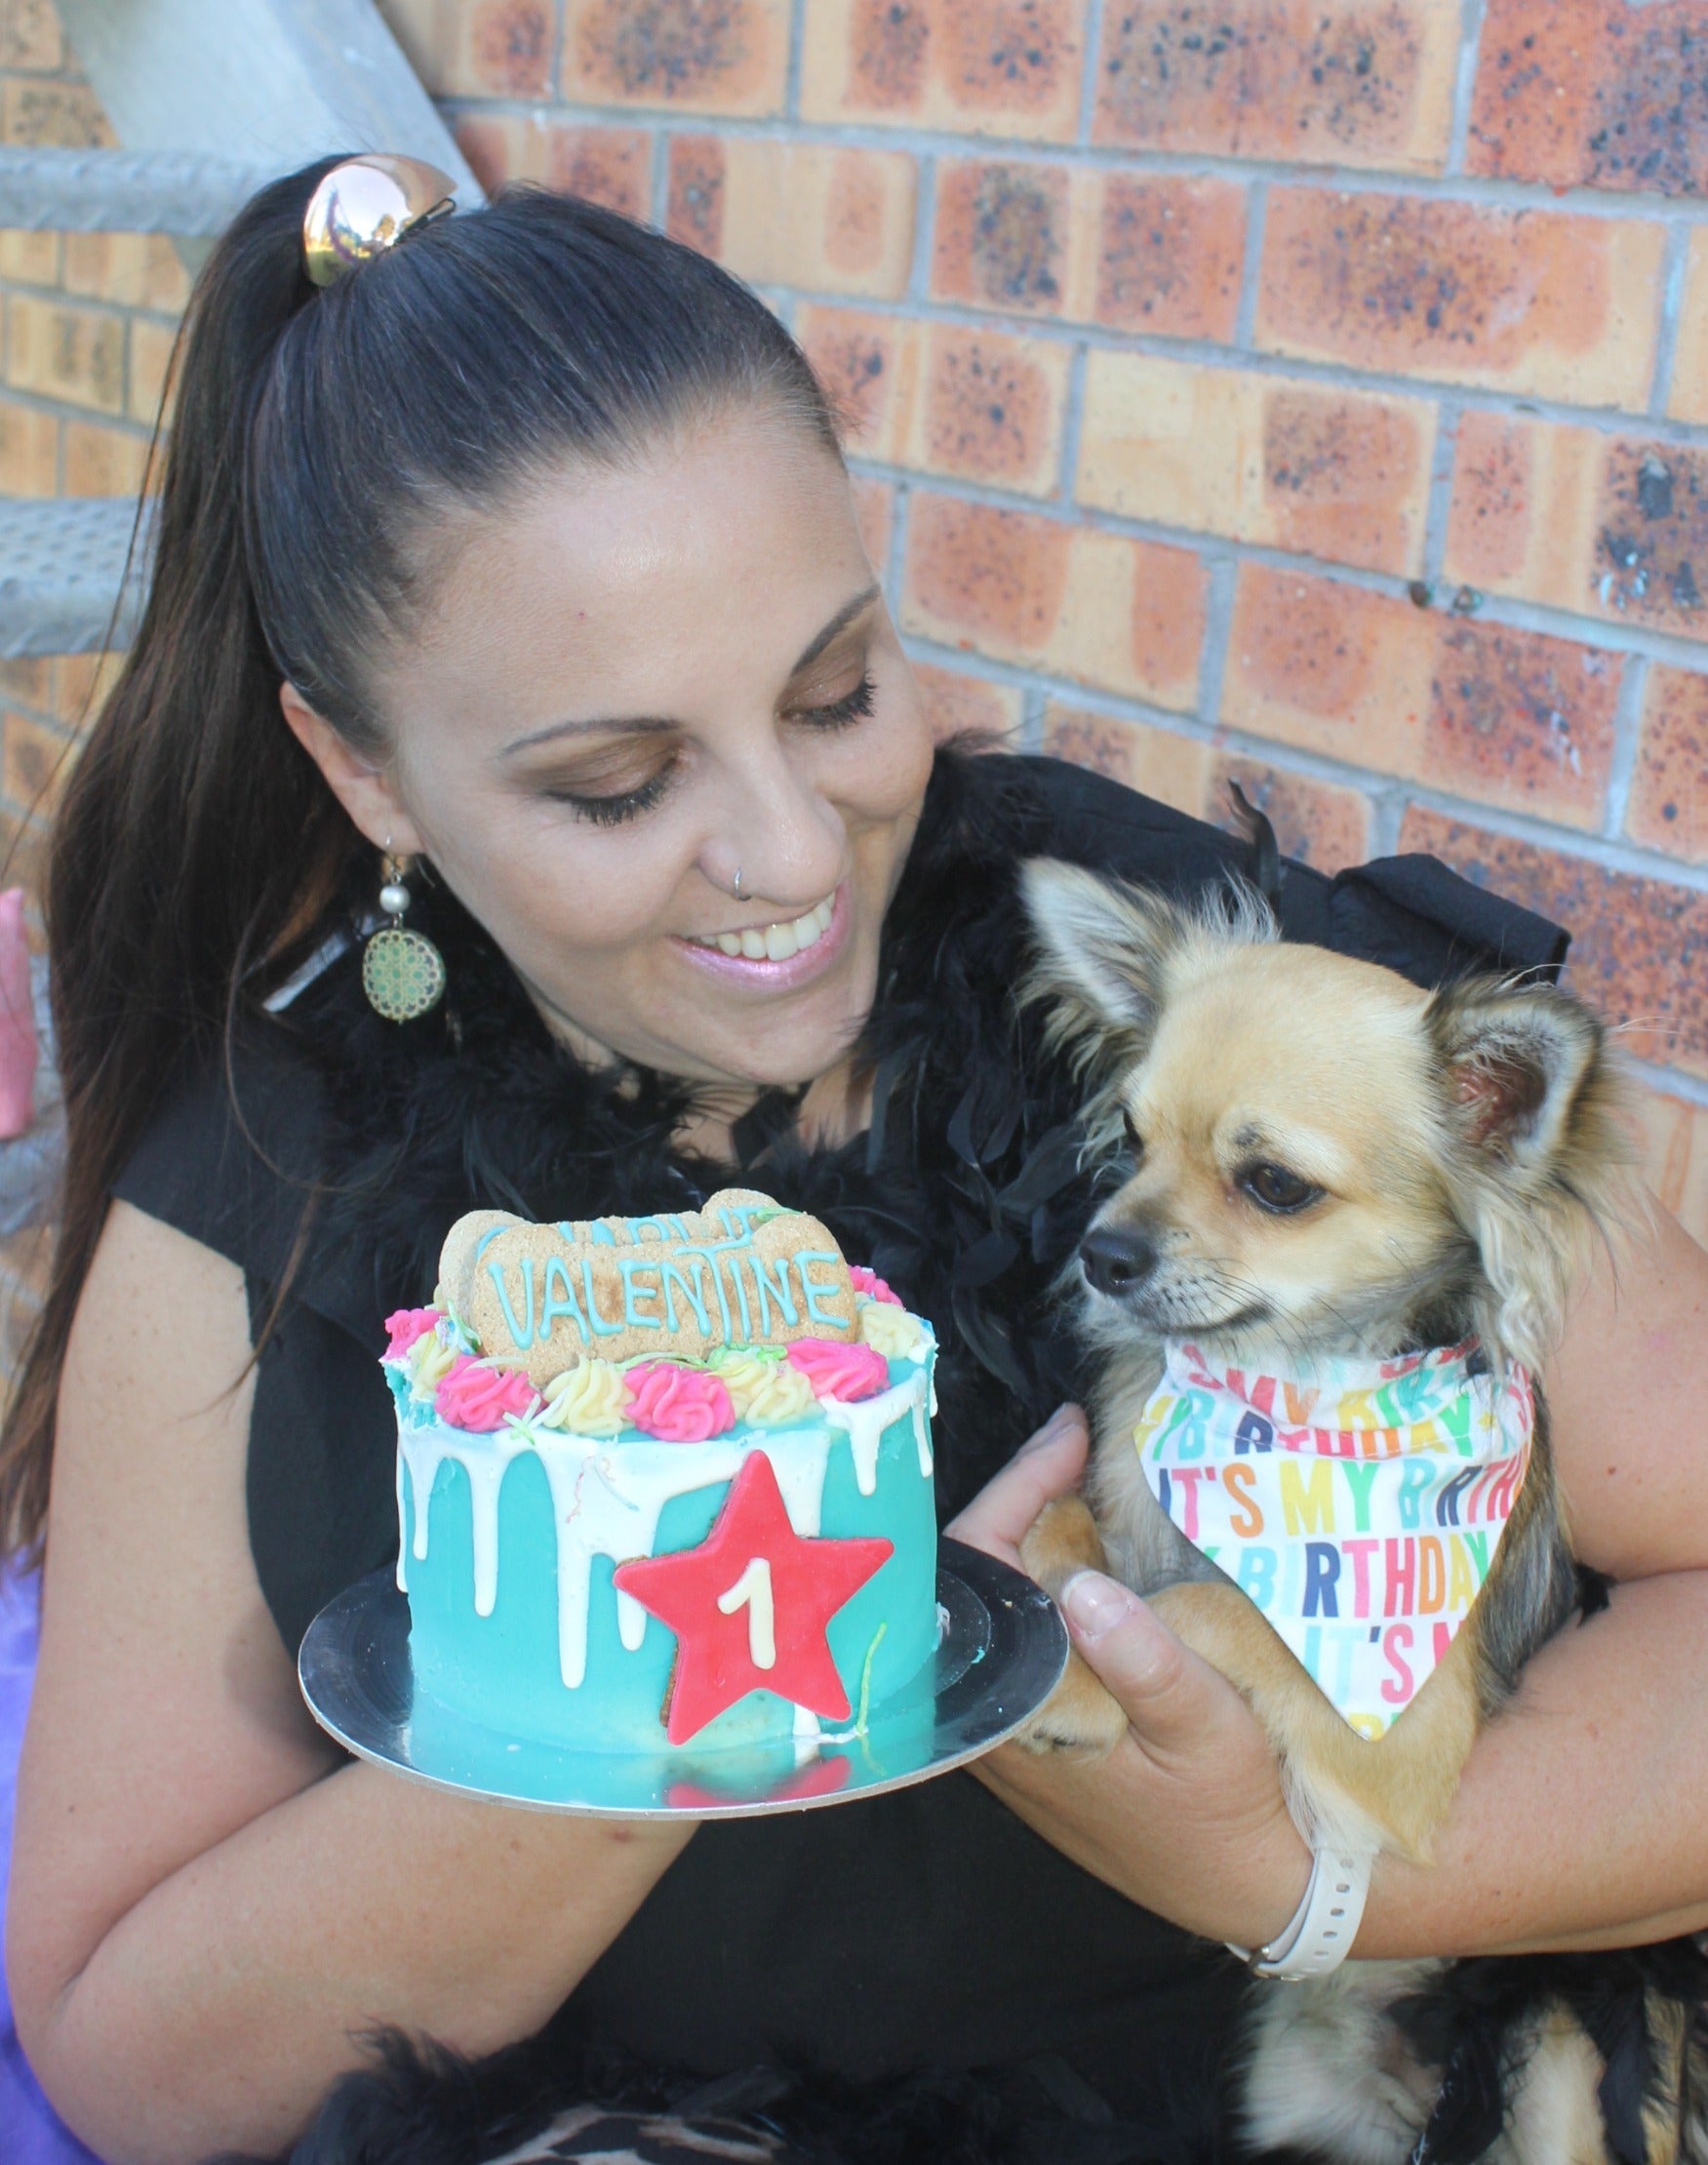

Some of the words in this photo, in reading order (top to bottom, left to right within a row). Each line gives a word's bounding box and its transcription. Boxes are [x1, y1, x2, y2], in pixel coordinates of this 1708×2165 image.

[488, 1233, 851, 1350] VALENTINE
[1159, 1463, 1265, 1541] IT'S
[1279, 1460, 1381, 1537] MY
[1397, 1447, 1529, 1530] BIRTH
[718, 1557, 776, 1669] 1
[1238, 1530, 1490, 1619] BIRTHDAY
[1303, 1623, 1414, 1705] IT'S
